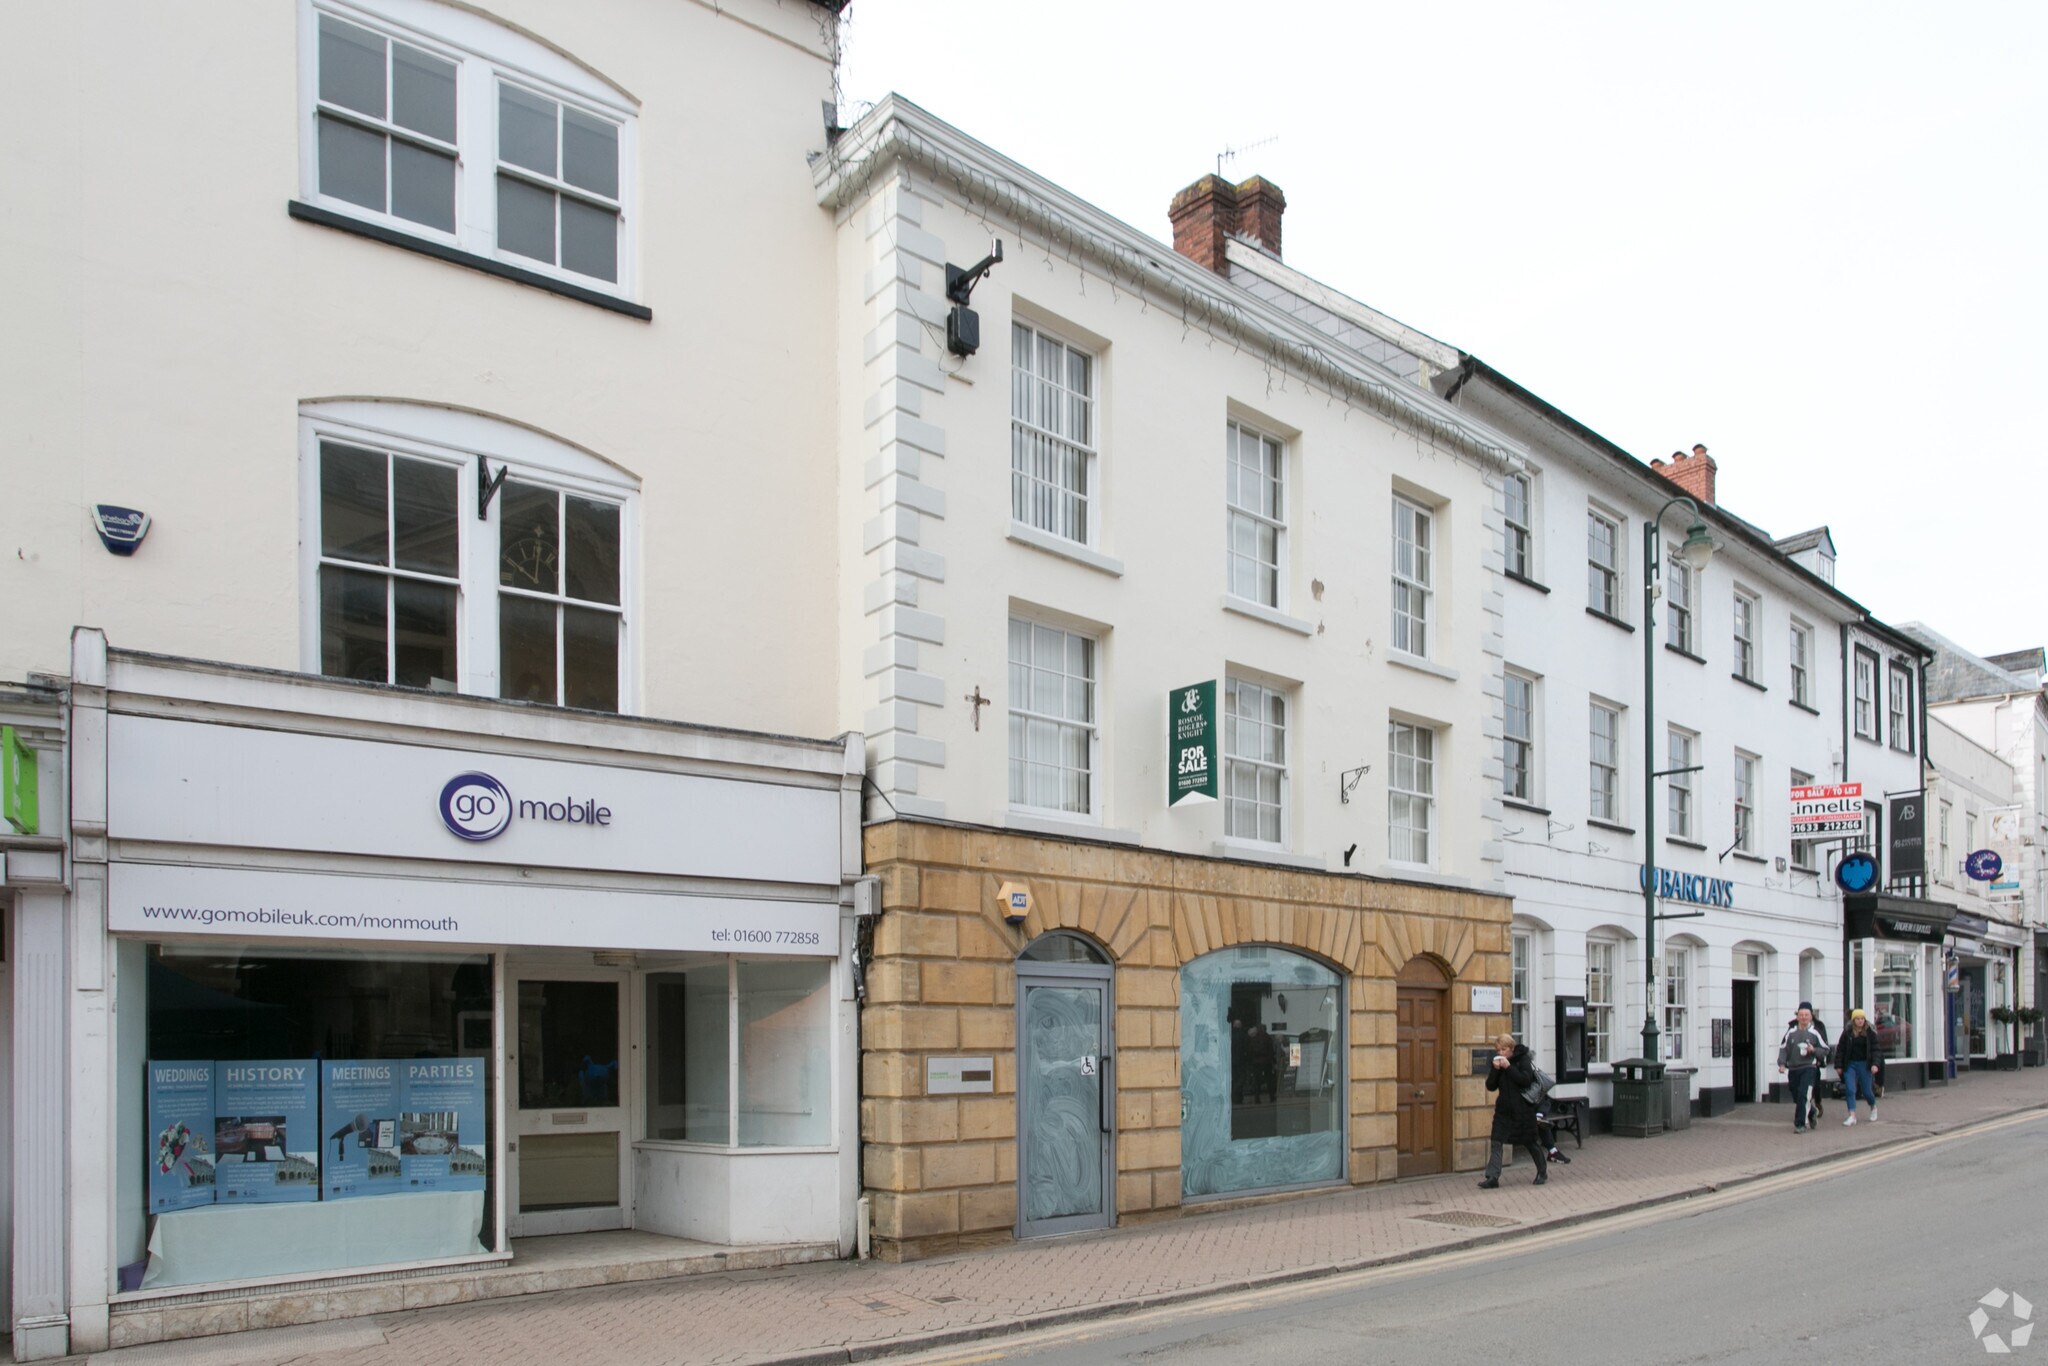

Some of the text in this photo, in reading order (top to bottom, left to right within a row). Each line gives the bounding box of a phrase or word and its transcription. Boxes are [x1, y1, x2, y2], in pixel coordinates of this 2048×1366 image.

[1178, 713, 1204, 726] ROSCOE
[1178, 728, 1204, 740] KNIGHT
[1181, 745, 1204, 762] FOR
[1178, 757, 1207, 775] SALE
[1807, 789, 1825, 797] SALE
[1844, 786, 1857, 794] LET
[456, 794, 612, 826] go mobile
[1791, 799, 1862, 815] innells
[1824, 821, 1859, 831] 212266
[1661, 868, 1733, 908] BARCLAYS
[142, 906, 458, 931] www.gomobileuk.com/monmouth
[712, 929, 820, 945] tel: 01600 772858
[155, 1068, 209, 1083] WEDDINGS
[227, 1067, 305, 1081] HISTORY
[332, 1066, 391, 1080] MEETINGS
[409, 1065, 474, 1078] PARTIES
